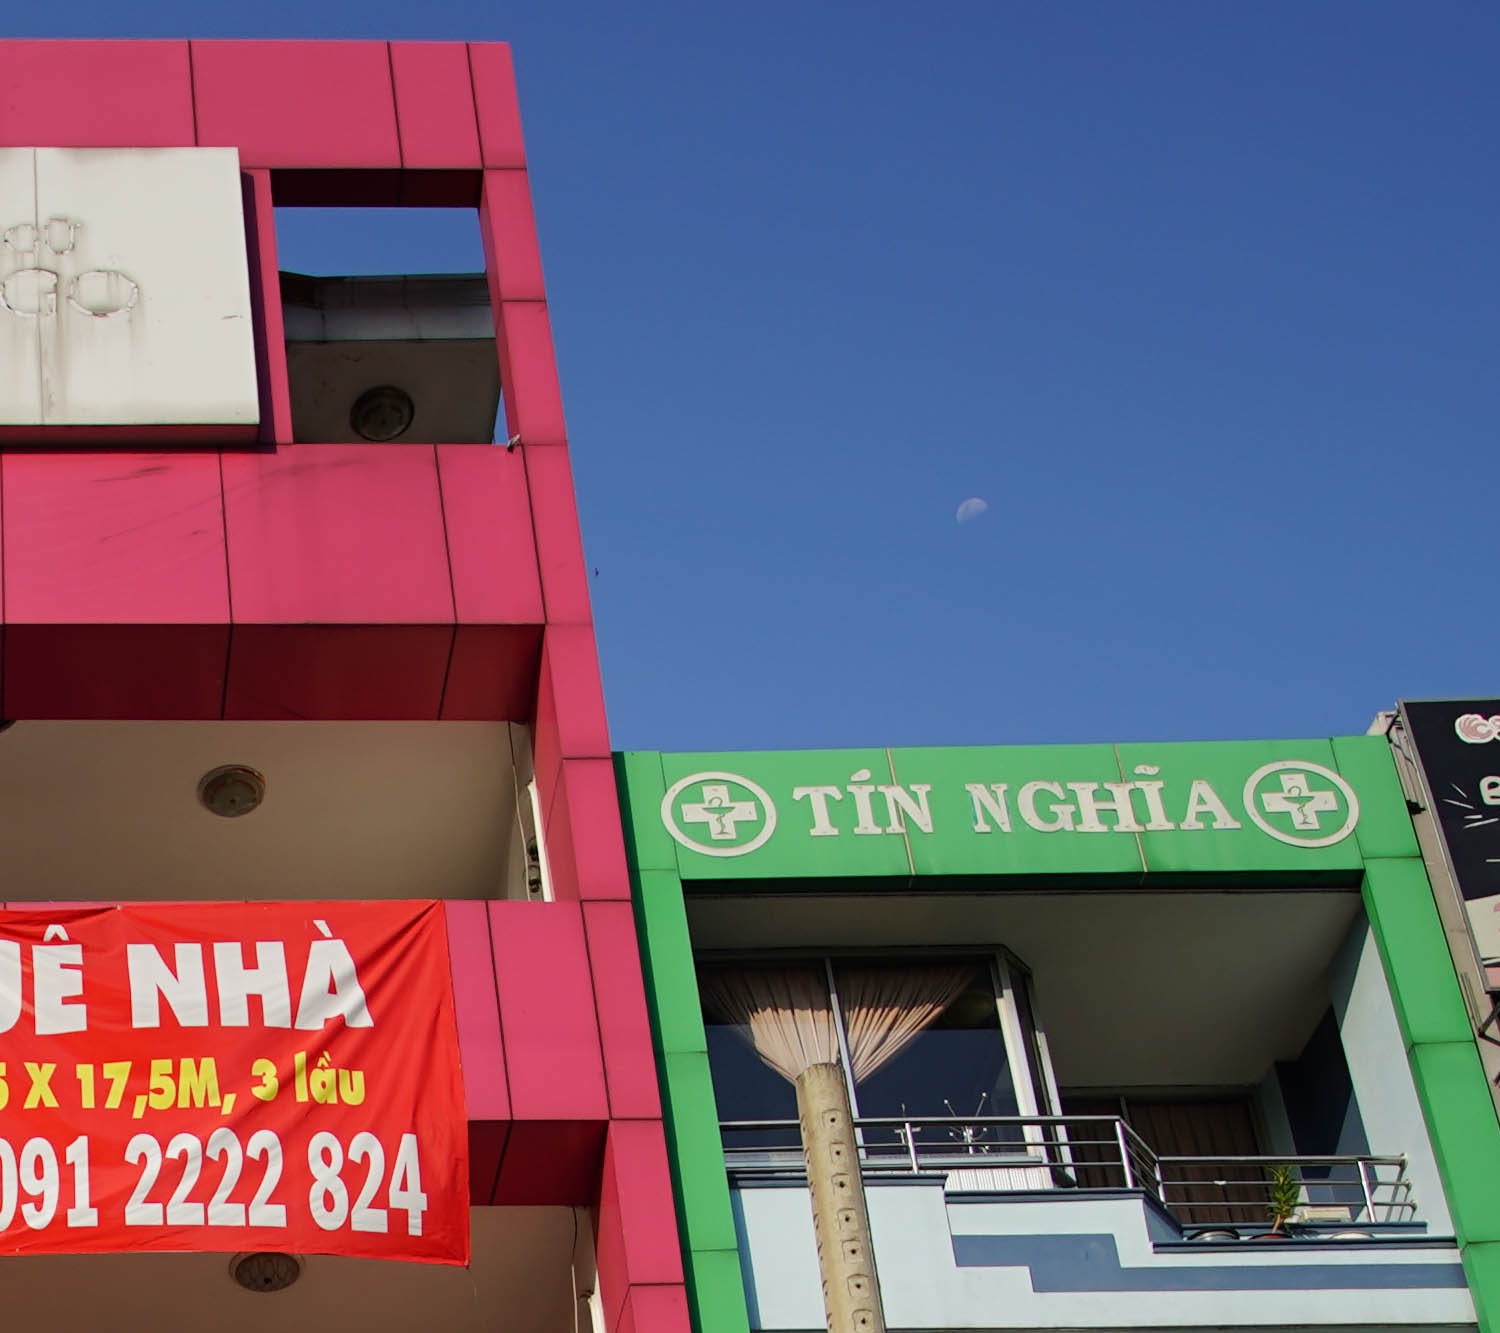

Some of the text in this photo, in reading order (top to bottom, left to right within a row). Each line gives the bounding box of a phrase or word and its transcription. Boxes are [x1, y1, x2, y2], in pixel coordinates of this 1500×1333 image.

[792, 764, 1243, 838] TÍN NGHĨA
[129, 918, 374, 1033] NHÀ
[25, 1061, 57, 1108] X
[73, 1058, 237, 1119] 17,5M,
[249, 1058, 277, 1102] 3
[293, 1050, 367, 1108] lầu
[123, 1128, 288, 1233] 2222
[307, 1131, 429, 1239] 824
